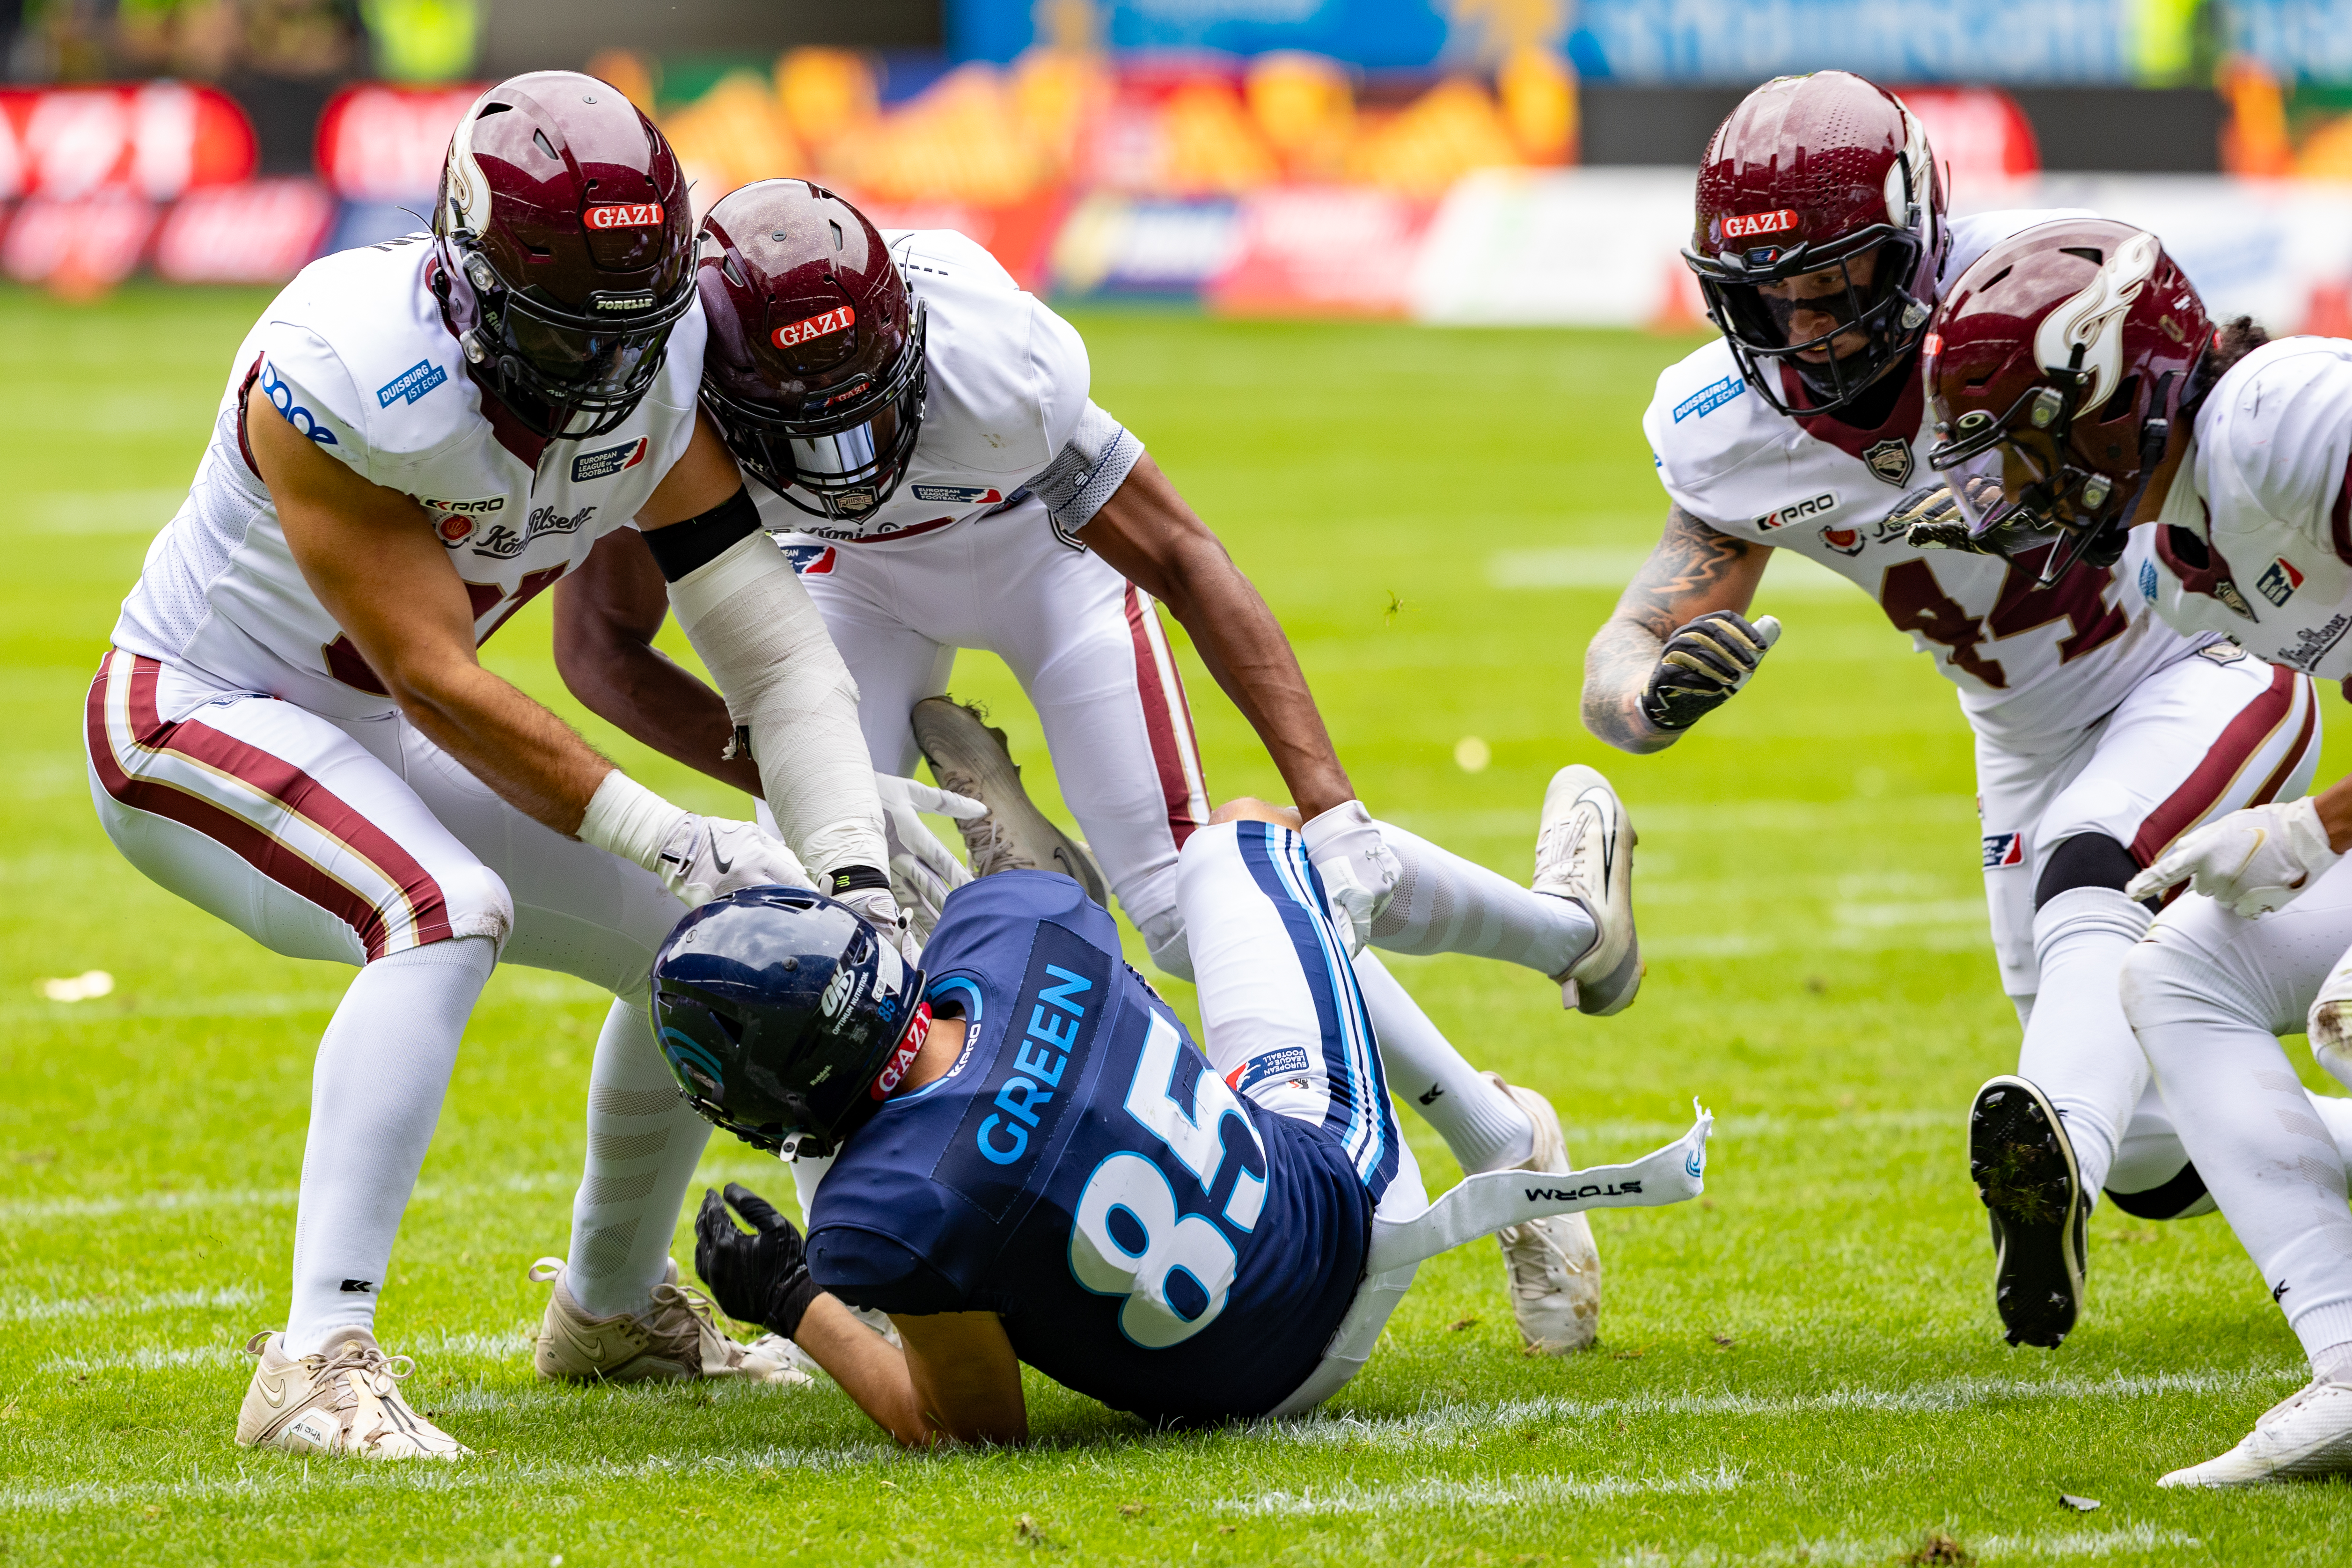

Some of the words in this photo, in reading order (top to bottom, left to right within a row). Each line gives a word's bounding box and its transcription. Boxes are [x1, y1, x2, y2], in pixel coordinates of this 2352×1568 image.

[596, 298, 653, 310] FORELLE
[381, 365, 429, 403] DUISBURG
[408, 384, 421, 400] IST
[421, 370, 442, 390] ECHT
[1675, 380, 1729, 419] DUISBURG
[1700, 398, 1715, 413] IST
[1715, 383, 1740, 403] ECHT
[579, 451, 617, 465] EUROPEAN
[579, 461, 606, 472] LEAGUE
[578, 466, 614, 479] FOOTBALL
[835, 495, 874, 509] FIRE
[832, 1004, 855, 1036] OPTIMUM
[878, 996, 896, 1022] 85
[976, 964, 1092, 1165] GREEN
[1262, 1049, 1304, 1063] FOOTBALL
[1275, 1055, 1305, 1064] LEAGUE
[1264, 1061, 1307, 1076] EUROPEAN
[1067, 1006, 1269, 1350] 85
[1525, 1180, 1642, 1202] STORM
